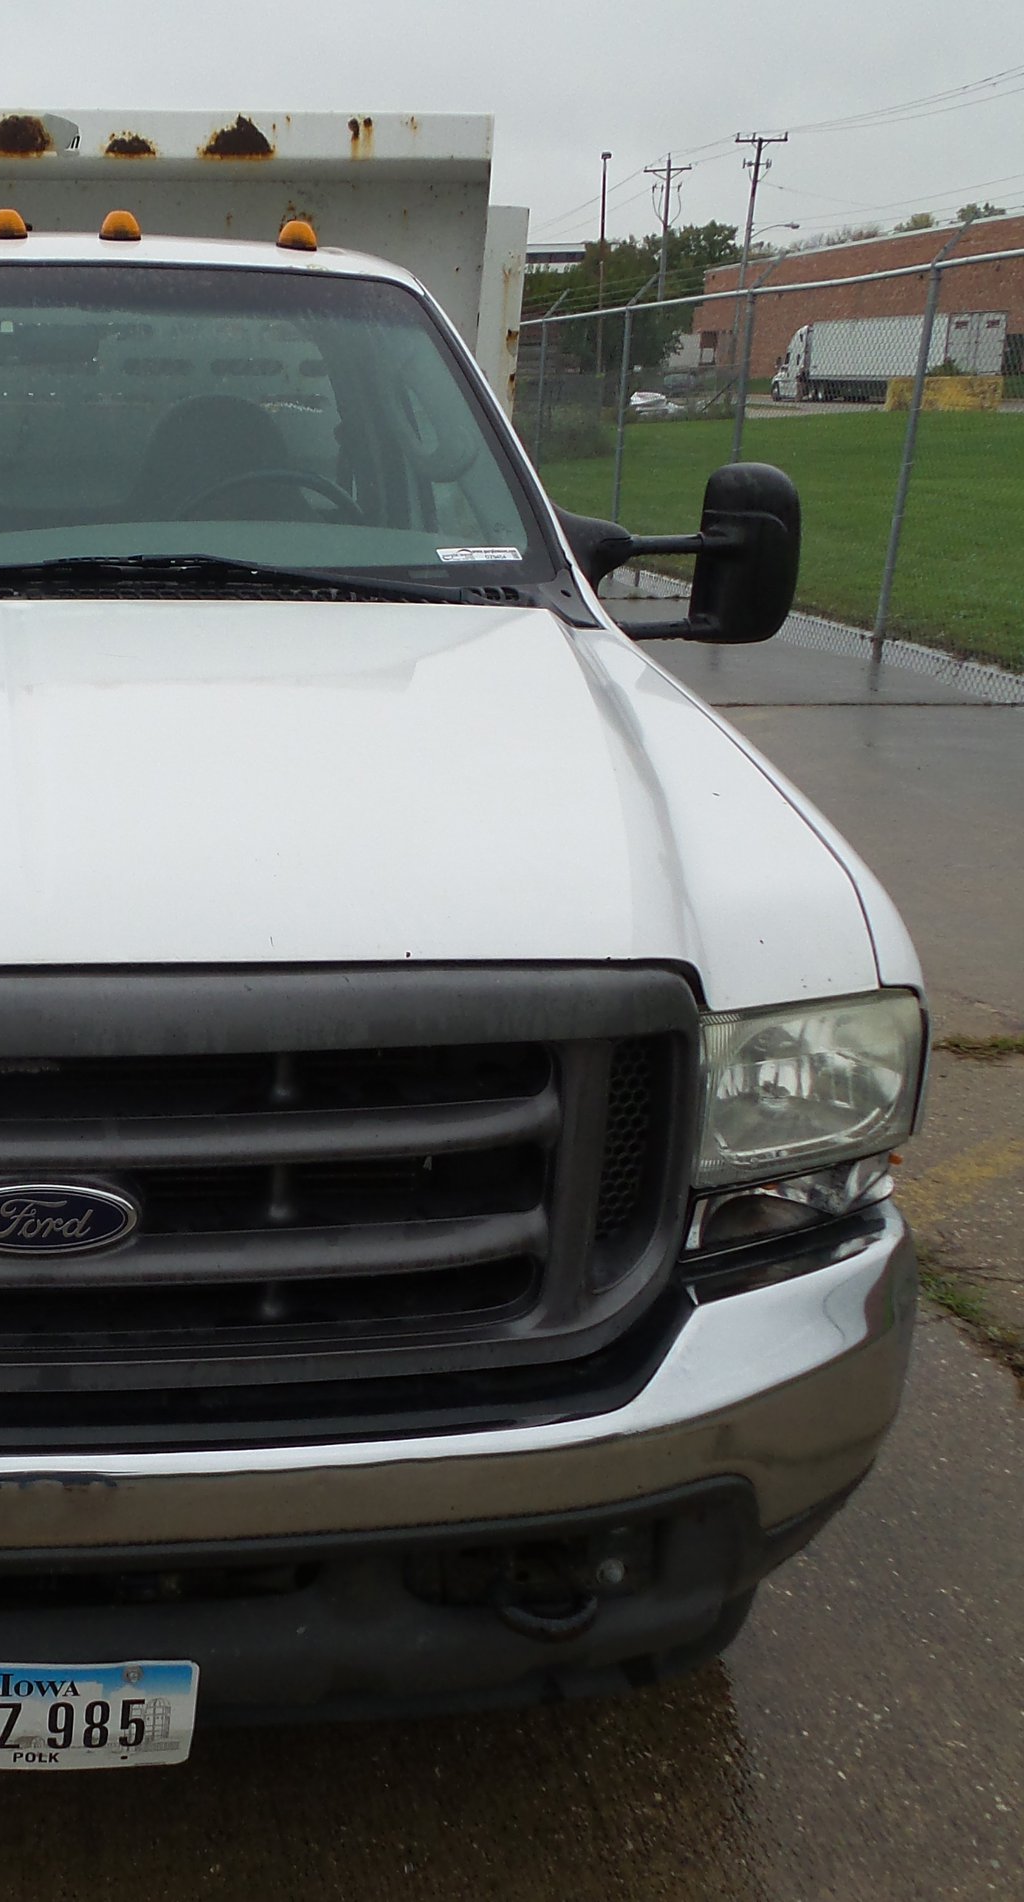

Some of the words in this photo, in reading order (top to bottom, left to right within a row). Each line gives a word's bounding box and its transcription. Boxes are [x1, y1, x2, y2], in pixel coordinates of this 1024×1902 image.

[0, 1673, 80, 1697] IOWA
[47, 1698, 146, 1750] 985
[12, 1751, 60, 1763] POLK
